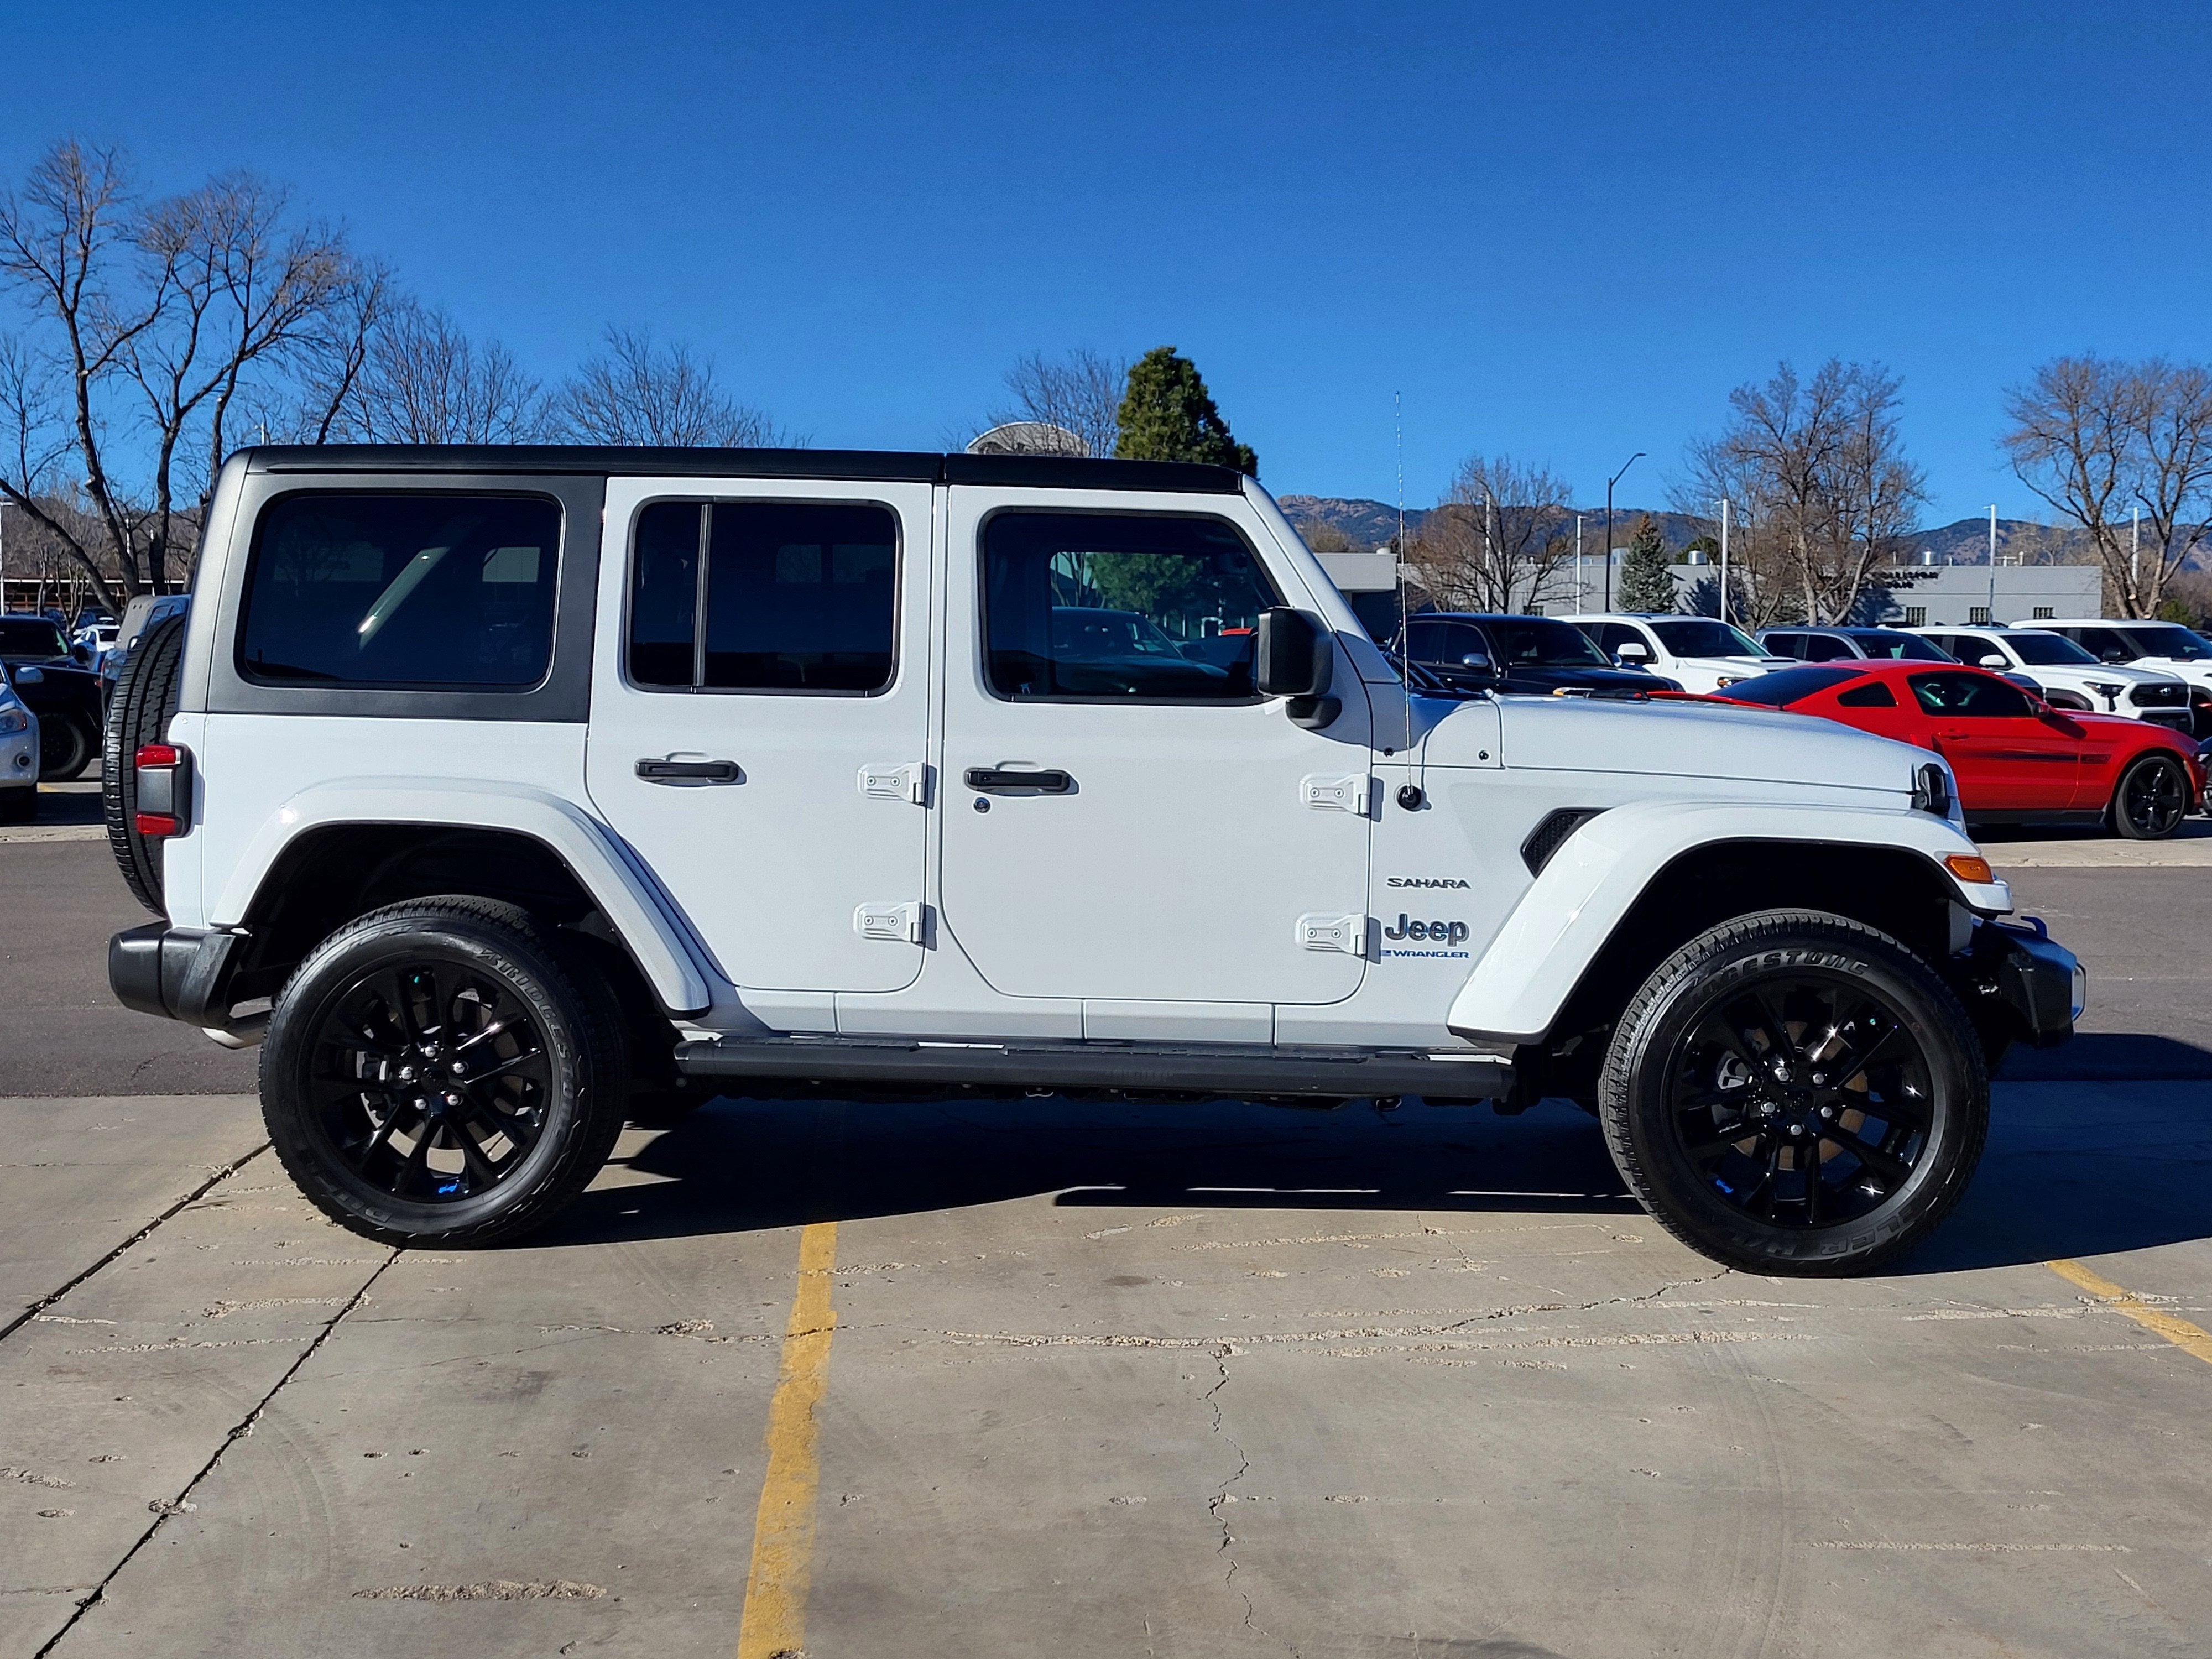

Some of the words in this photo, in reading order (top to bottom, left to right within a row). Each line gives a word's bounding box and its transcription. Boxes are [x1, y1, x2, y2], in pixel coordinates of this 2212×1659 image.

[1387, 878, 1472, 889] SAHARA
[1385, 914, 1469, 947] Jeep
[1393, 950, 1469, 958] WRANGLER
